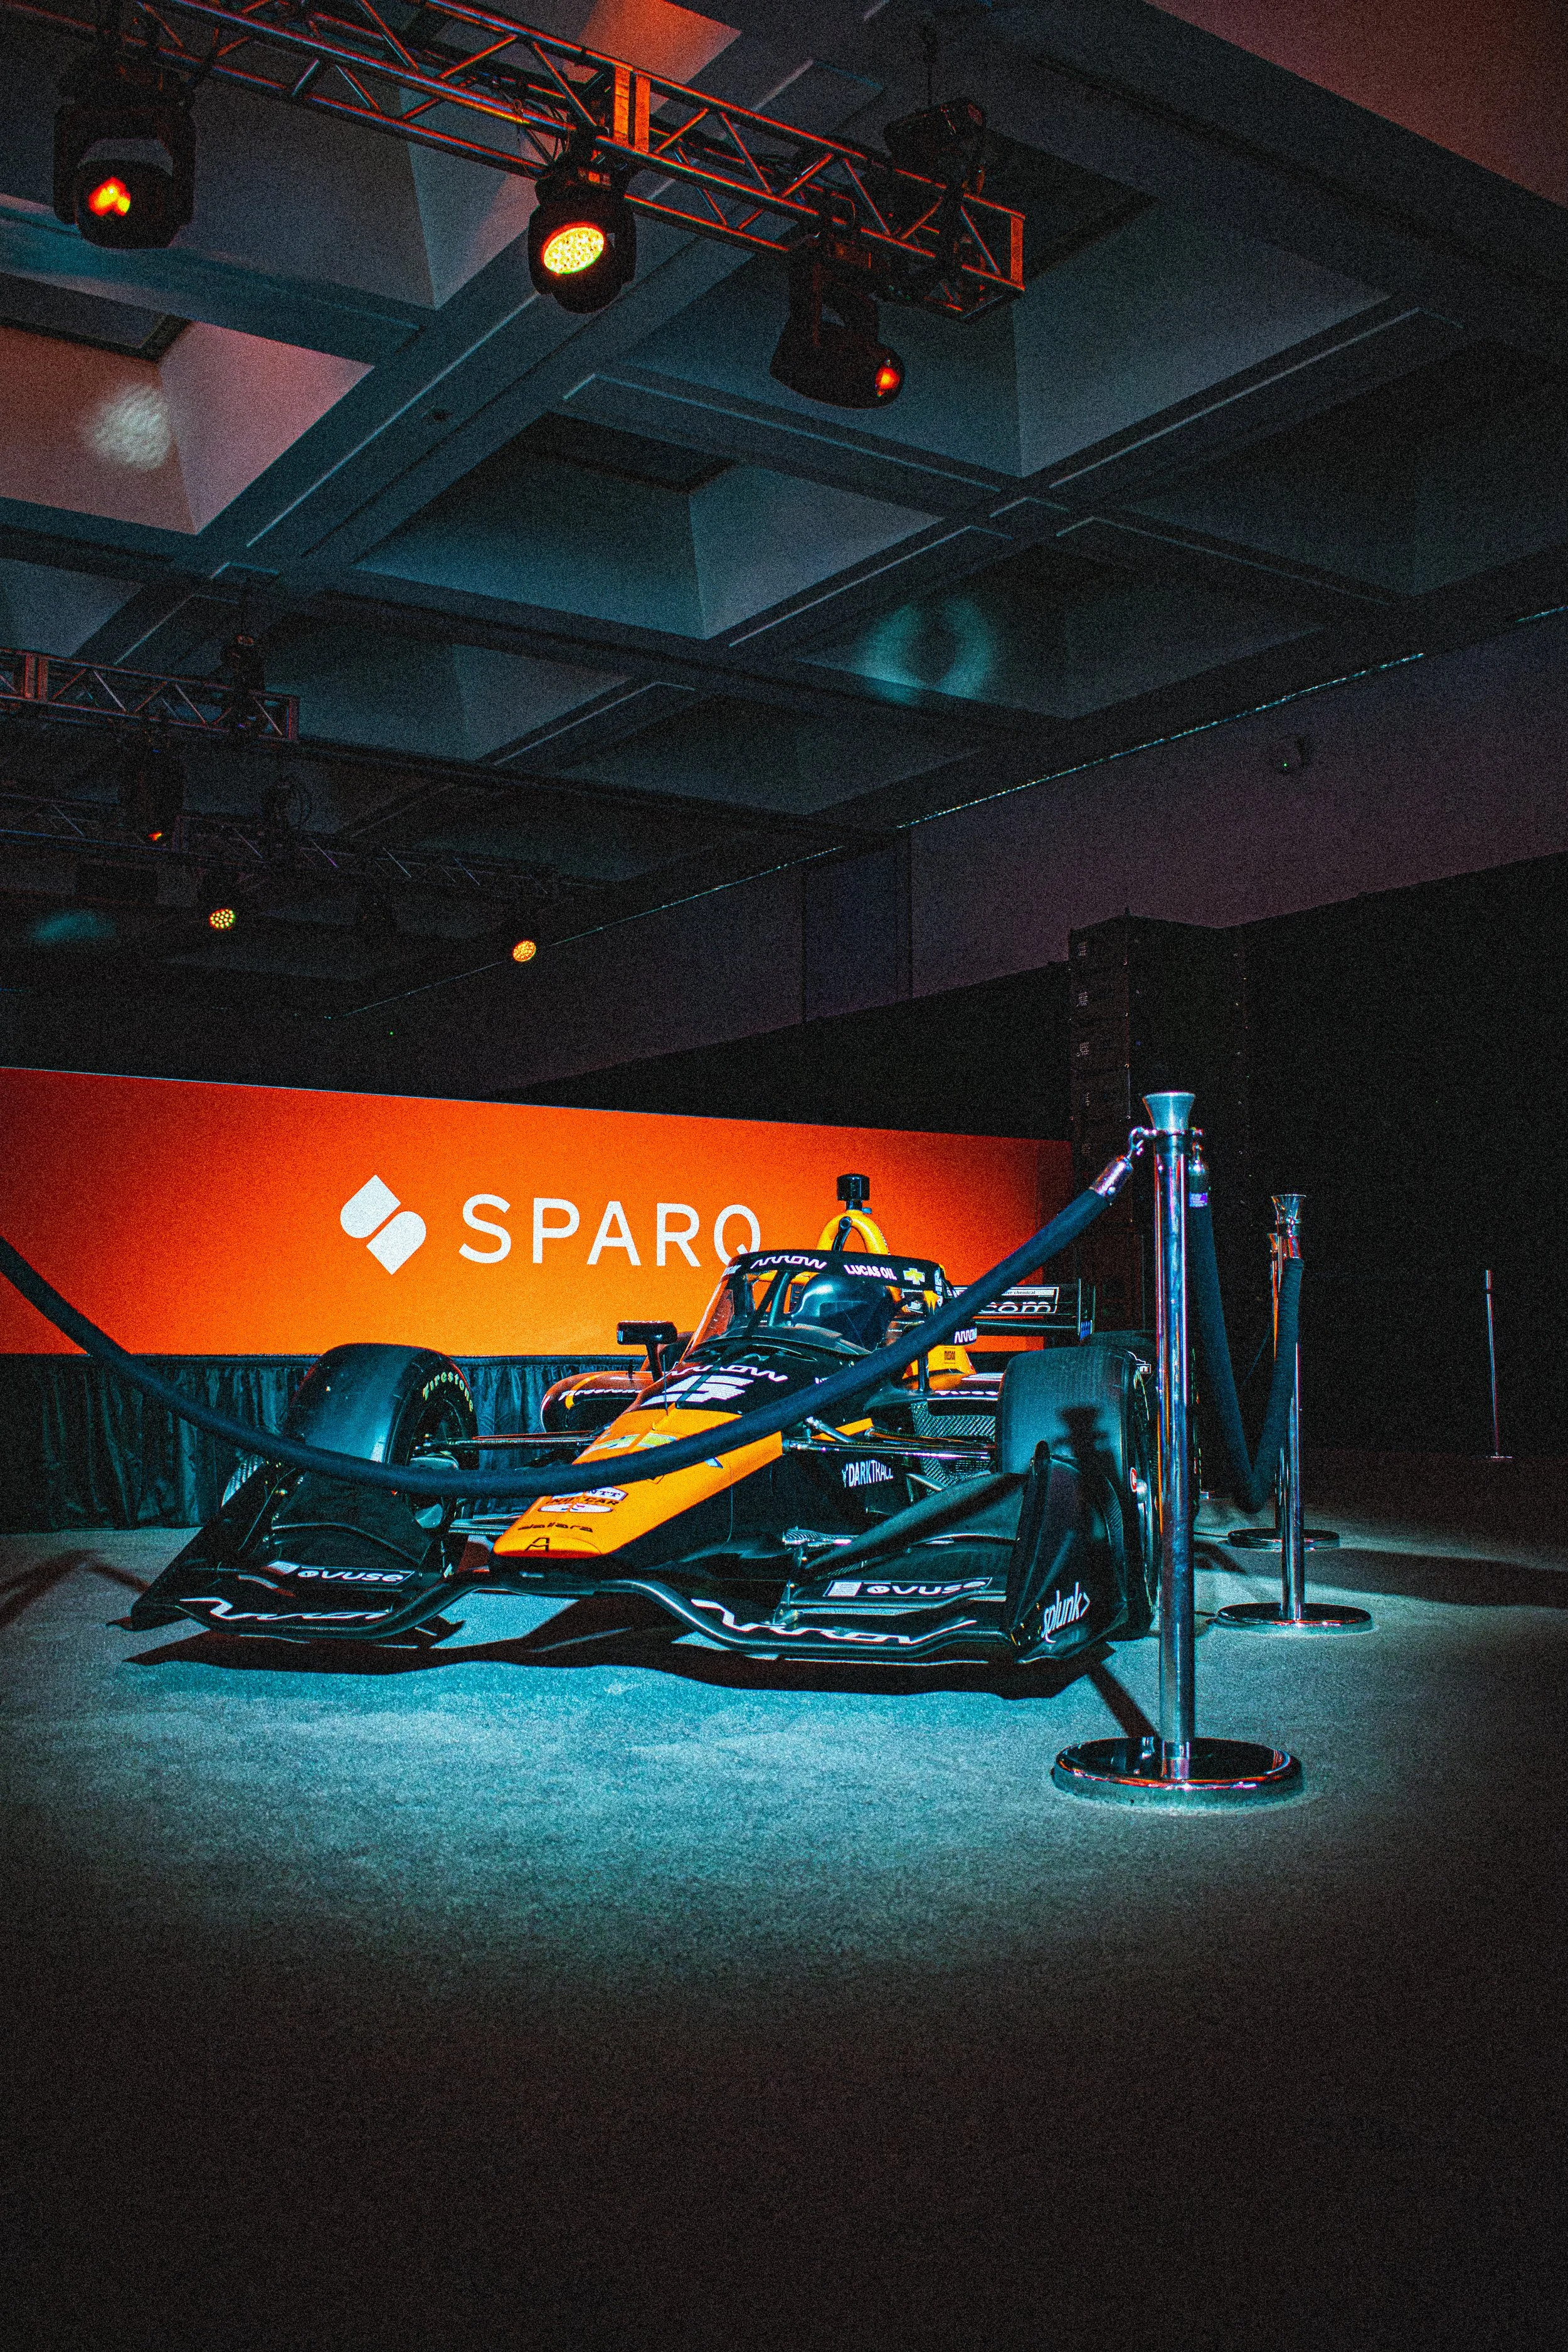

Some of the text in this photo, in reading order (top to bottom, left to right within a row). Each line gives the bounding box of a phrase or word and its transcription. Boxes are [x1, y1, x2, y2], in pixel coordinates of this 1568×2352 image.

[458, 1194, 761, 1266] SPARQ
[750, 1255, 827, 1269] ARROW
[844, 1264, 898, 1281] LUCAS OIL
[422, 1371, 474, 1412] Firestone
